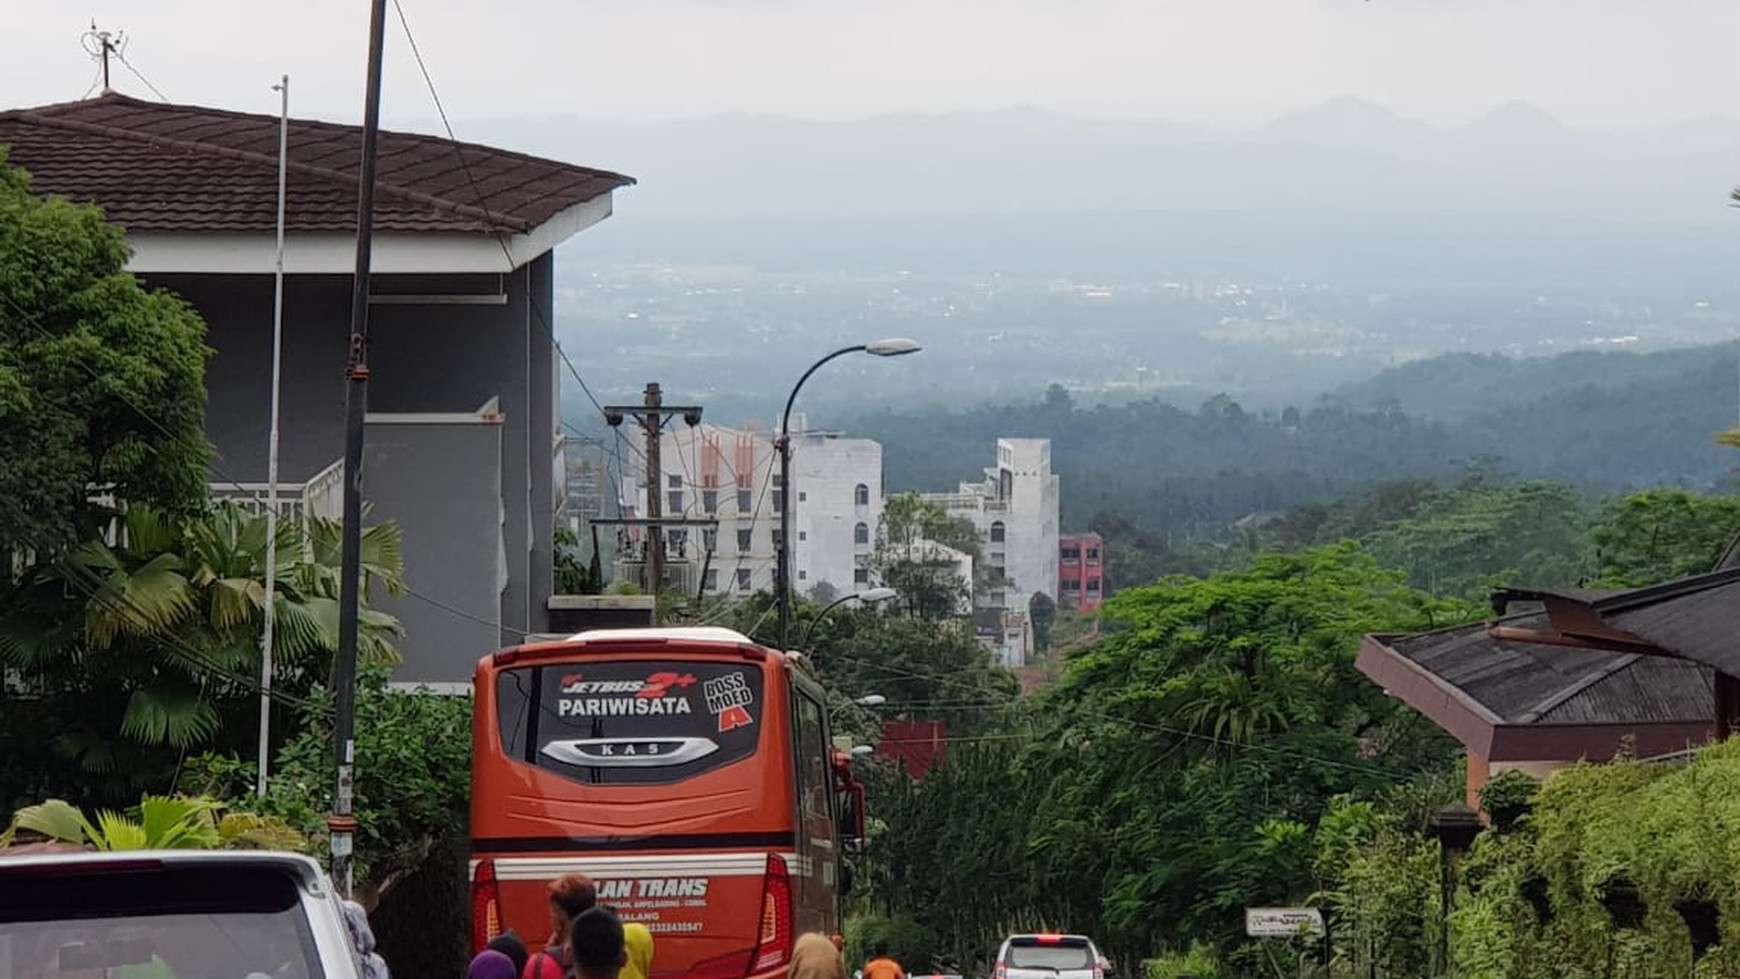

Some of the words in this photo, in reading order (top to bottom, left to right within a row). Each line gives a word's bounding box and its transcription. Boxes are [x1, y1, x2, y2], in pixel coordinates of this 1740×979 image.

[704, 671, 746, 699] BOSS
[559, 697, 691, 716] PARIWISATA
[719, 704, 754, 733] A
[638, 878, 709, 897] TRANS
